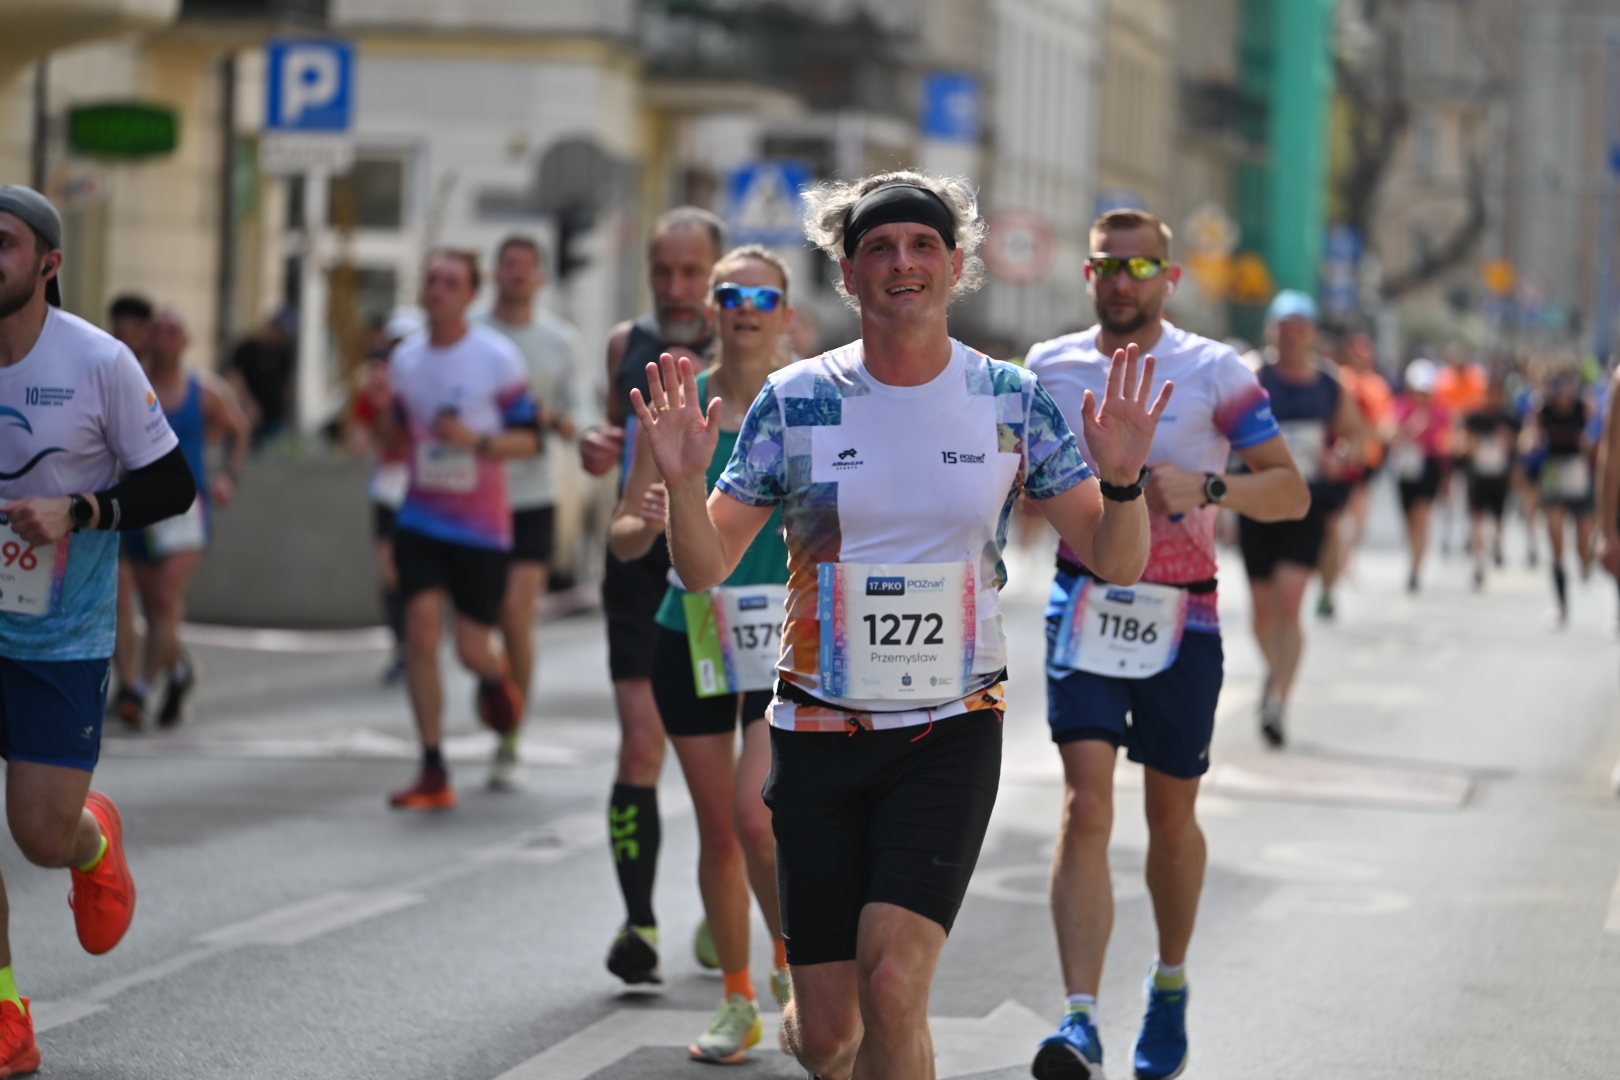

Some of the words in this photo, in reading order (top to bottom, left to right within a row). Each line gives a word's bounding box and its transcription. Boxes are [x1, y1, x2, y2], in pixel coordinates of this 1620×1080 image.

[281, 50, 341, 126] P
[25, 386, 39, 406] 10
[941, 451, 957, 464] 15
[0, 541, 38, 571] 96
[869, 581, 902, 591] 17.PKO
[863, 613, 944, 645] 1272
[1099, 612, 1158, 644] 1186
[870, 652, 938, 665] Przemysław
[823, 671, 831, 690] M45
